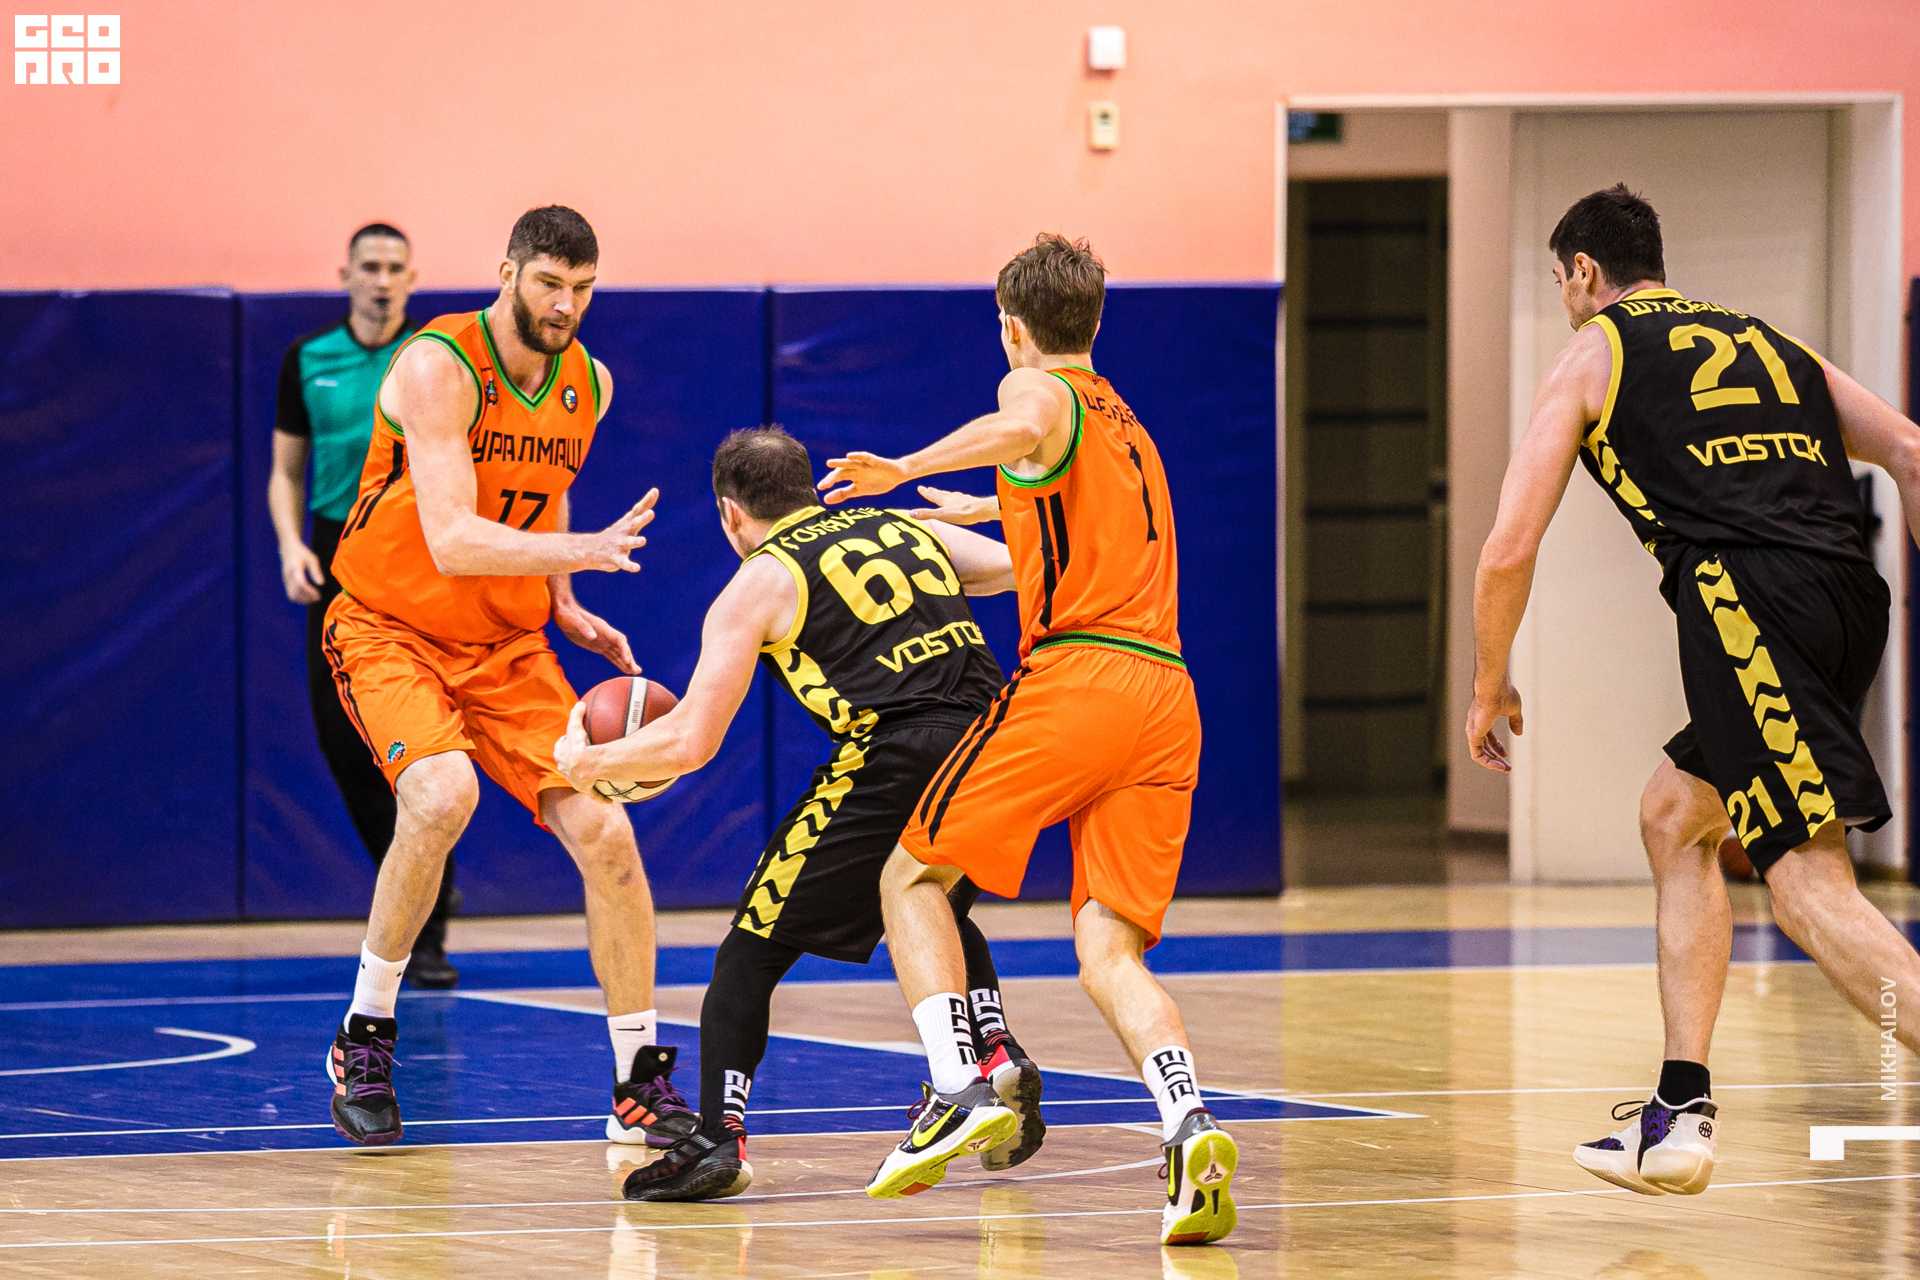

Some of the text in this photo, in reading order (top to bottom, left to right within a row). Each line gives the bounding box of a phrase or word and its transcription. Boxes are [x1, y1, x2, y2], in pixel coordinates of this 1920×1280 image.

[1669, 323, 1800, 411] 21
[472, 430, 582, 476] УРАЛМАШ
[1686, 432, 1828, 467] VOSTOK
[498, 488, 551, 531] 17
[819, 521, 961, 625] 63
[1727, 775, 1783, 850] 21
